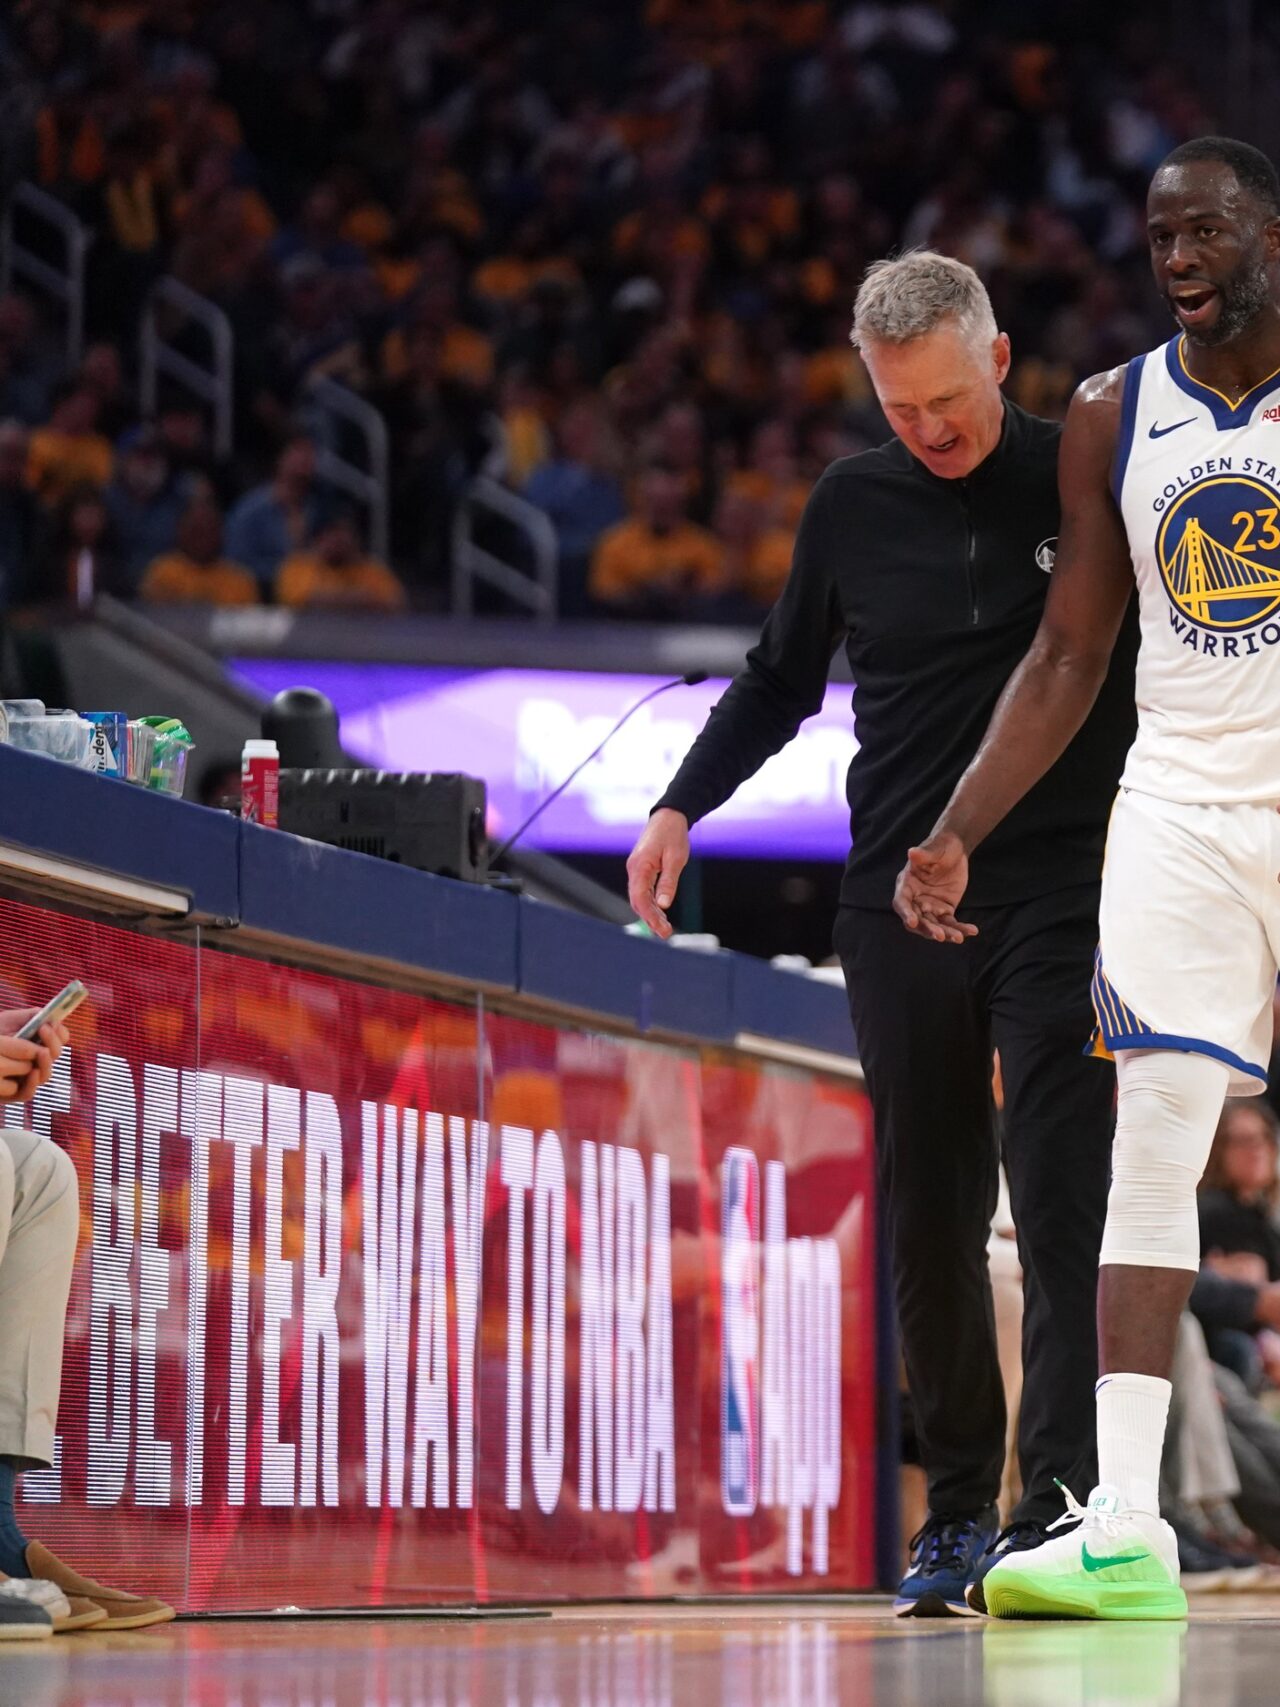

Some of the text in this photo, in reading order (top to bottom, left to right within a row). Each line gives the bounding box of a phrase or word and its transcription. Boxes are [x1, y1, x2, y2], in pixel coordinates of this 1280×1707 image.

[1152, 456, 1232, 513] GOLDEN
[86, 1052, 343, 1507] BETTER
[361, 1099, 490, 1509] WAY
[501, 1124, 567, 1515] TO
[578, 1139, 677, 1513] NBA
